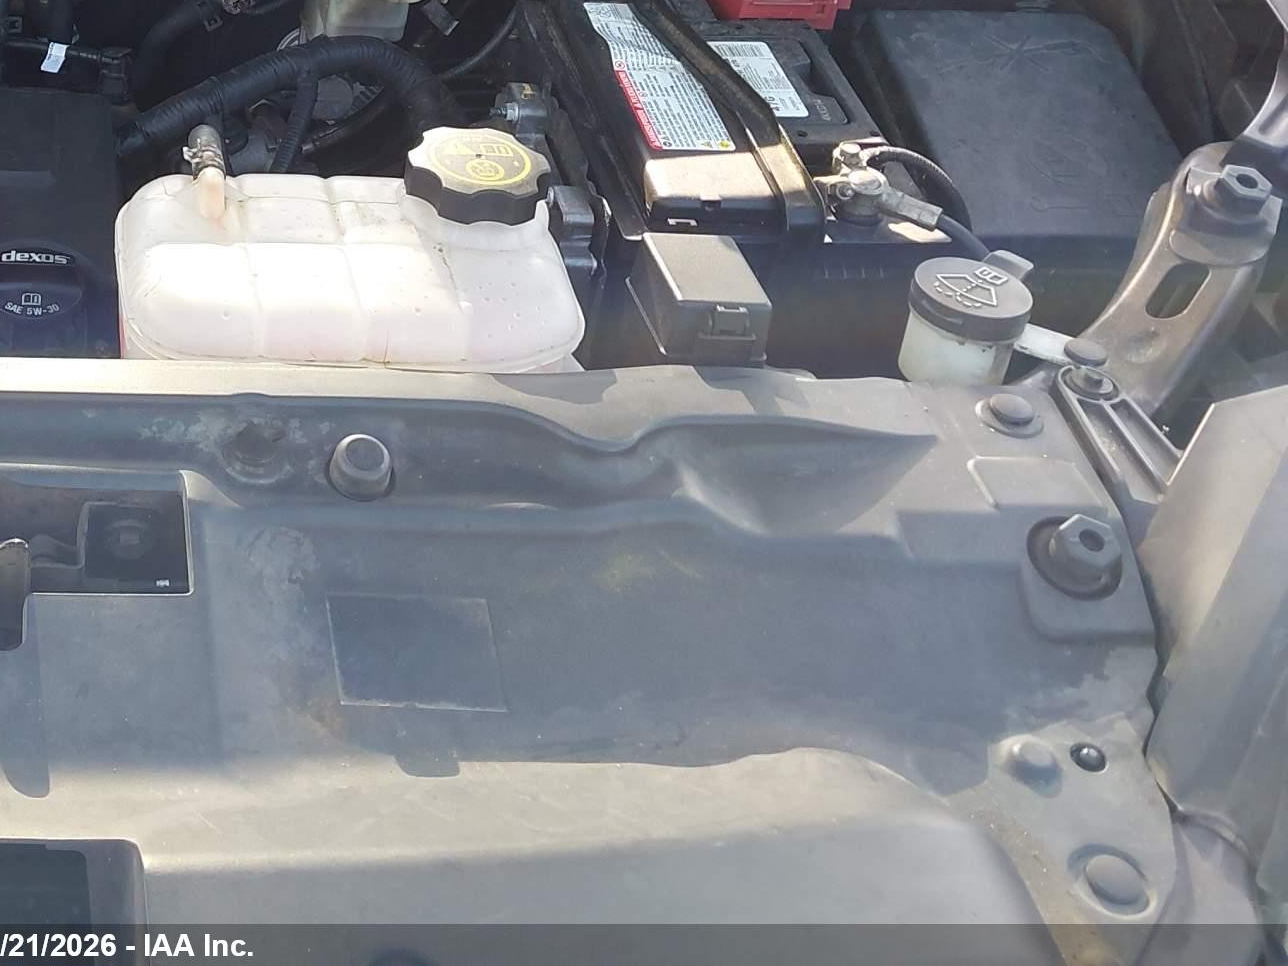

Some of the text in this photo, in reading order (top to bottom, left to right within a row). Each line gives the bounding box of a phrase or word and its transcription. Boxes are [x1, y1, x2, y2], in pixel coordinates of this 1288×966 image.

[1, 250, 71, 264] dexos
[4, 301, 60, 316] SAE 5W-30
